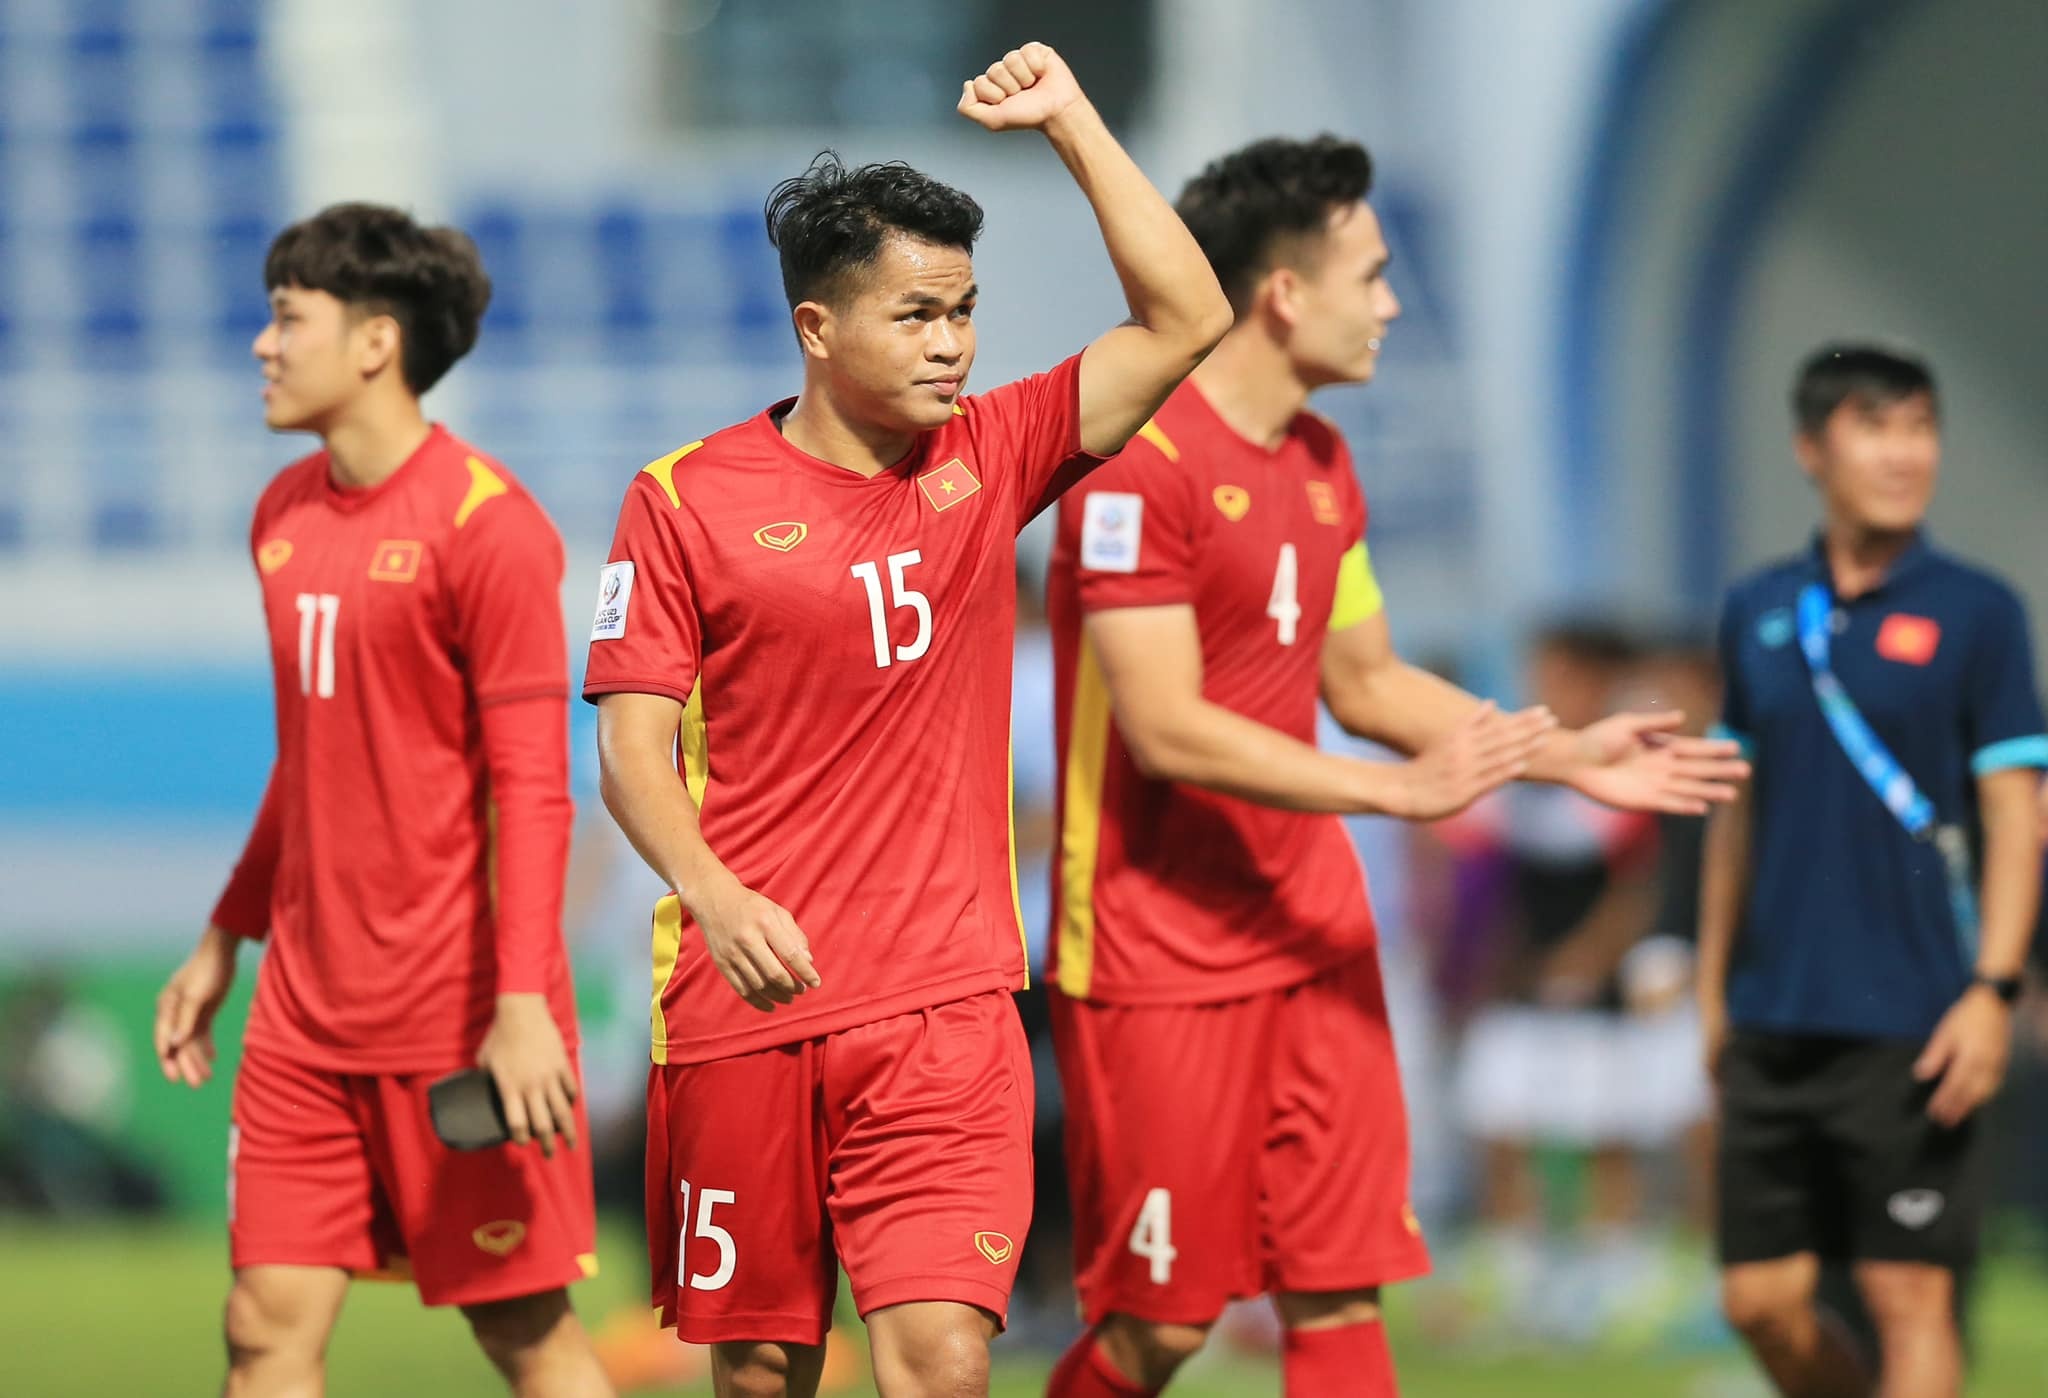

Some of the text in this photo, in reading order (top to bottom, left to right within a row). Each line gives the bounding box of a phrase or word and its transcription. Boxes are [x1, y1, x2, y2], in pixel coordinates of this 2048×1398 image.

[296, 592, 340, 698] 11
[850, 549, 933, 669] 15
[1266, 542, 1301, 646] 4
[677, 1178, 737, 1291] 15
[1129, 1187, 1178, 1285] 4
